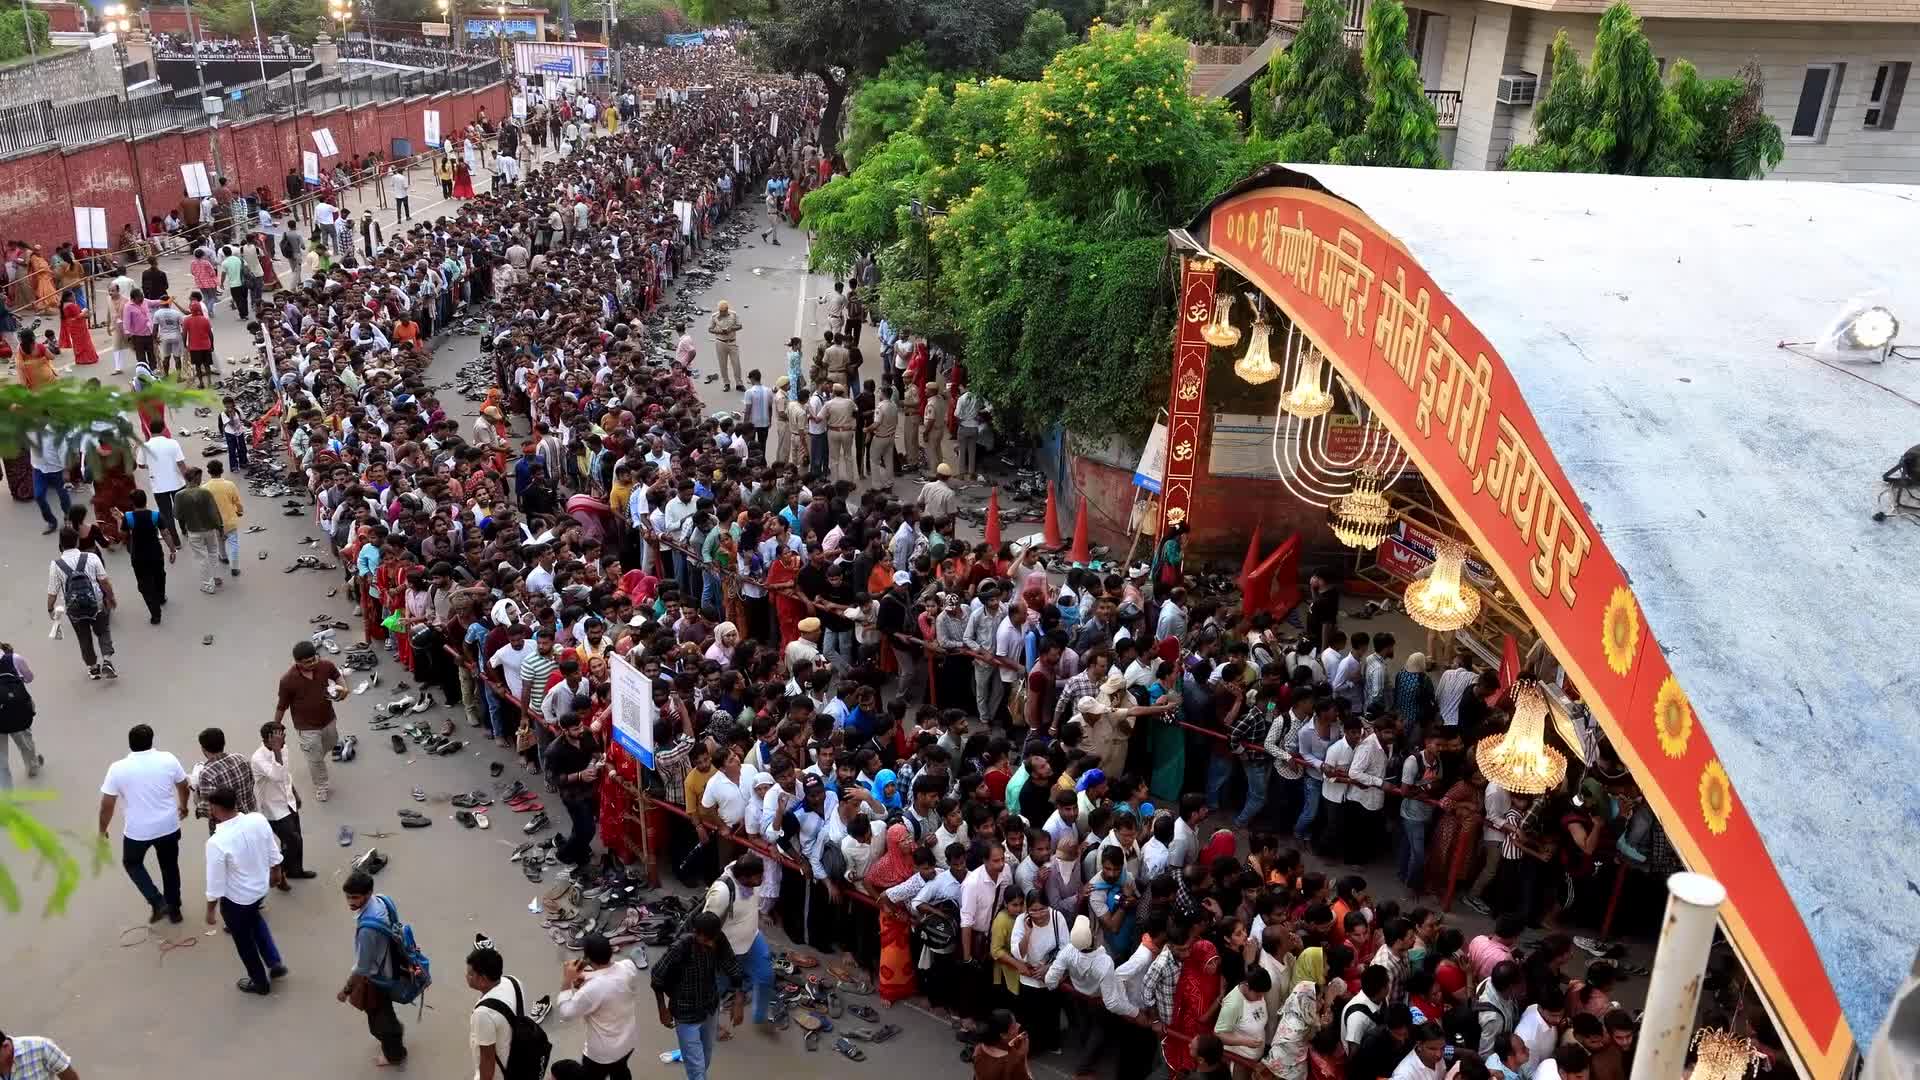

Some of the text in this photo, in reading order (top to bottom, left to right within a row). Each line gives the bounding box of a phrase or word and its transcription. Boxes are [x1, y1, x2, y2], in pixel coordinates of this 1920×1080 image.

[511, 20, 532, 31] FREE
[1261, 206, 1280, 267] श्री
[1276, 209, 1320, 297] गणेश
[1317, 226, 1377, 339] मन्दिर
[1374, 264, 1431, 392] मोती
[1486, 410, 1592, 609] जयपुर
